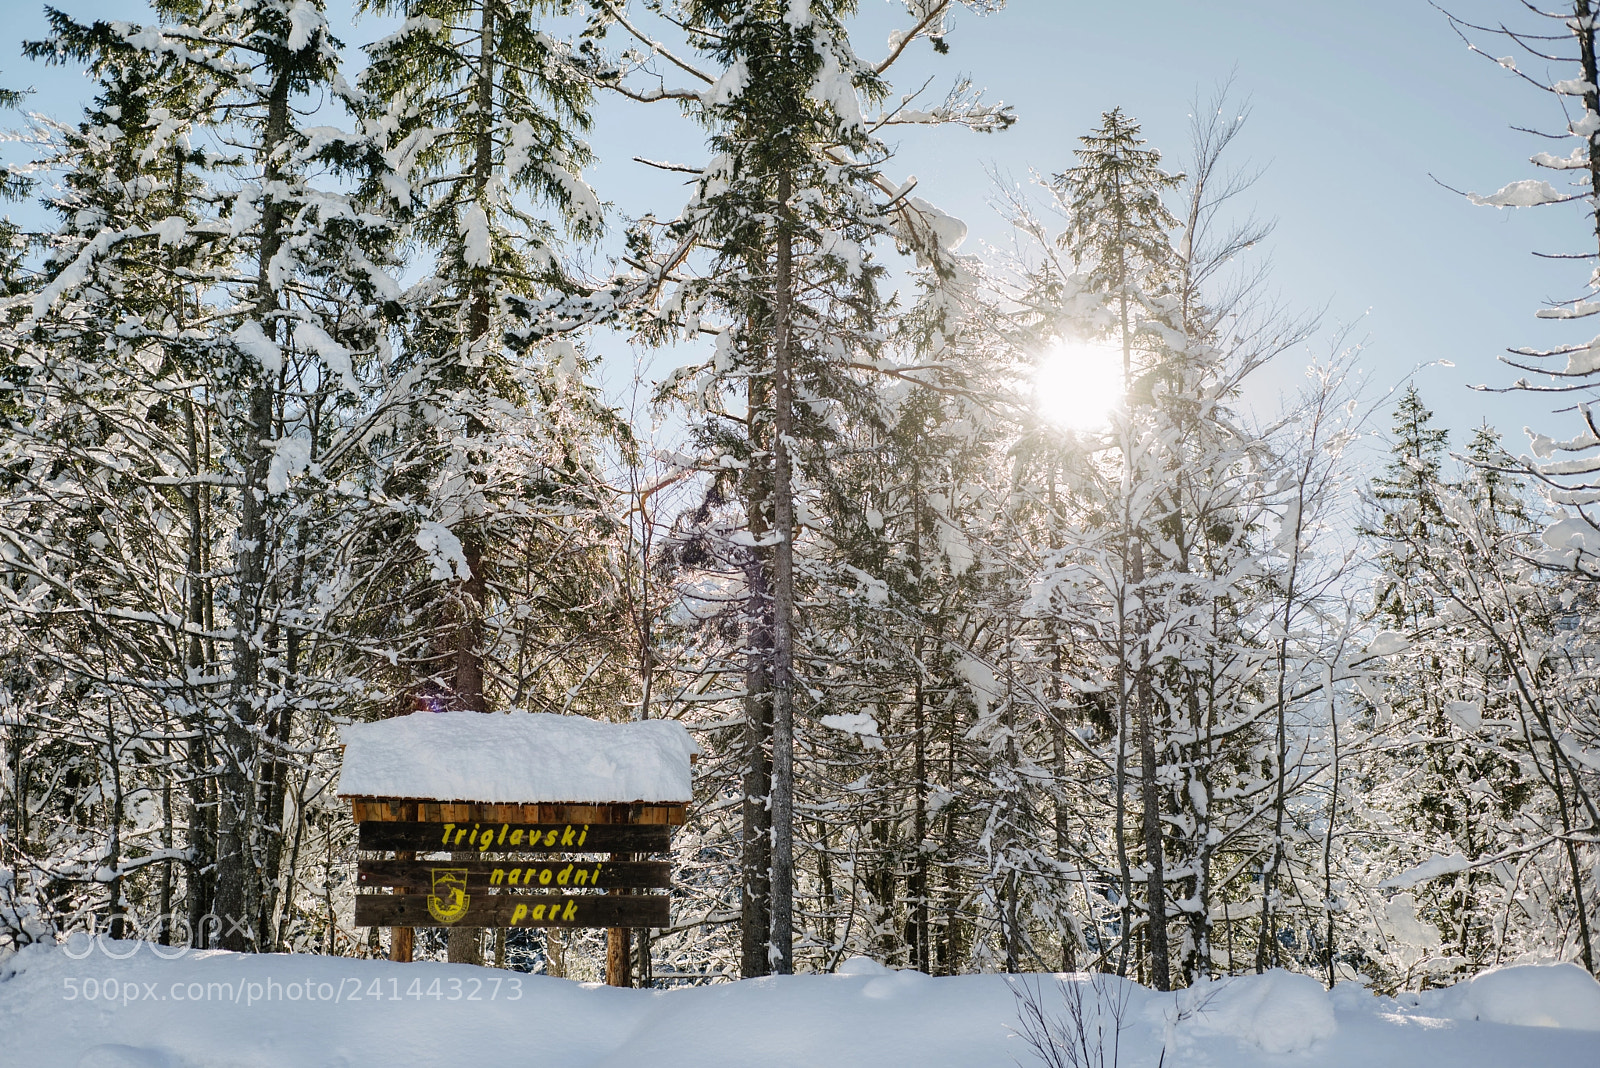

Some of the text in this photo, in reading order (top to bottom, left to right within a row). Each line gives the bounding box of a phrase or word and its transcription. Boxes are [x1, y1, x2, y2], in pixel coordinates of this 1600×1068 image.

[442, 823, 589, 851] Triglavski
[490, 864, 602, 886] narodni
[511, 900, 578, 925] park
